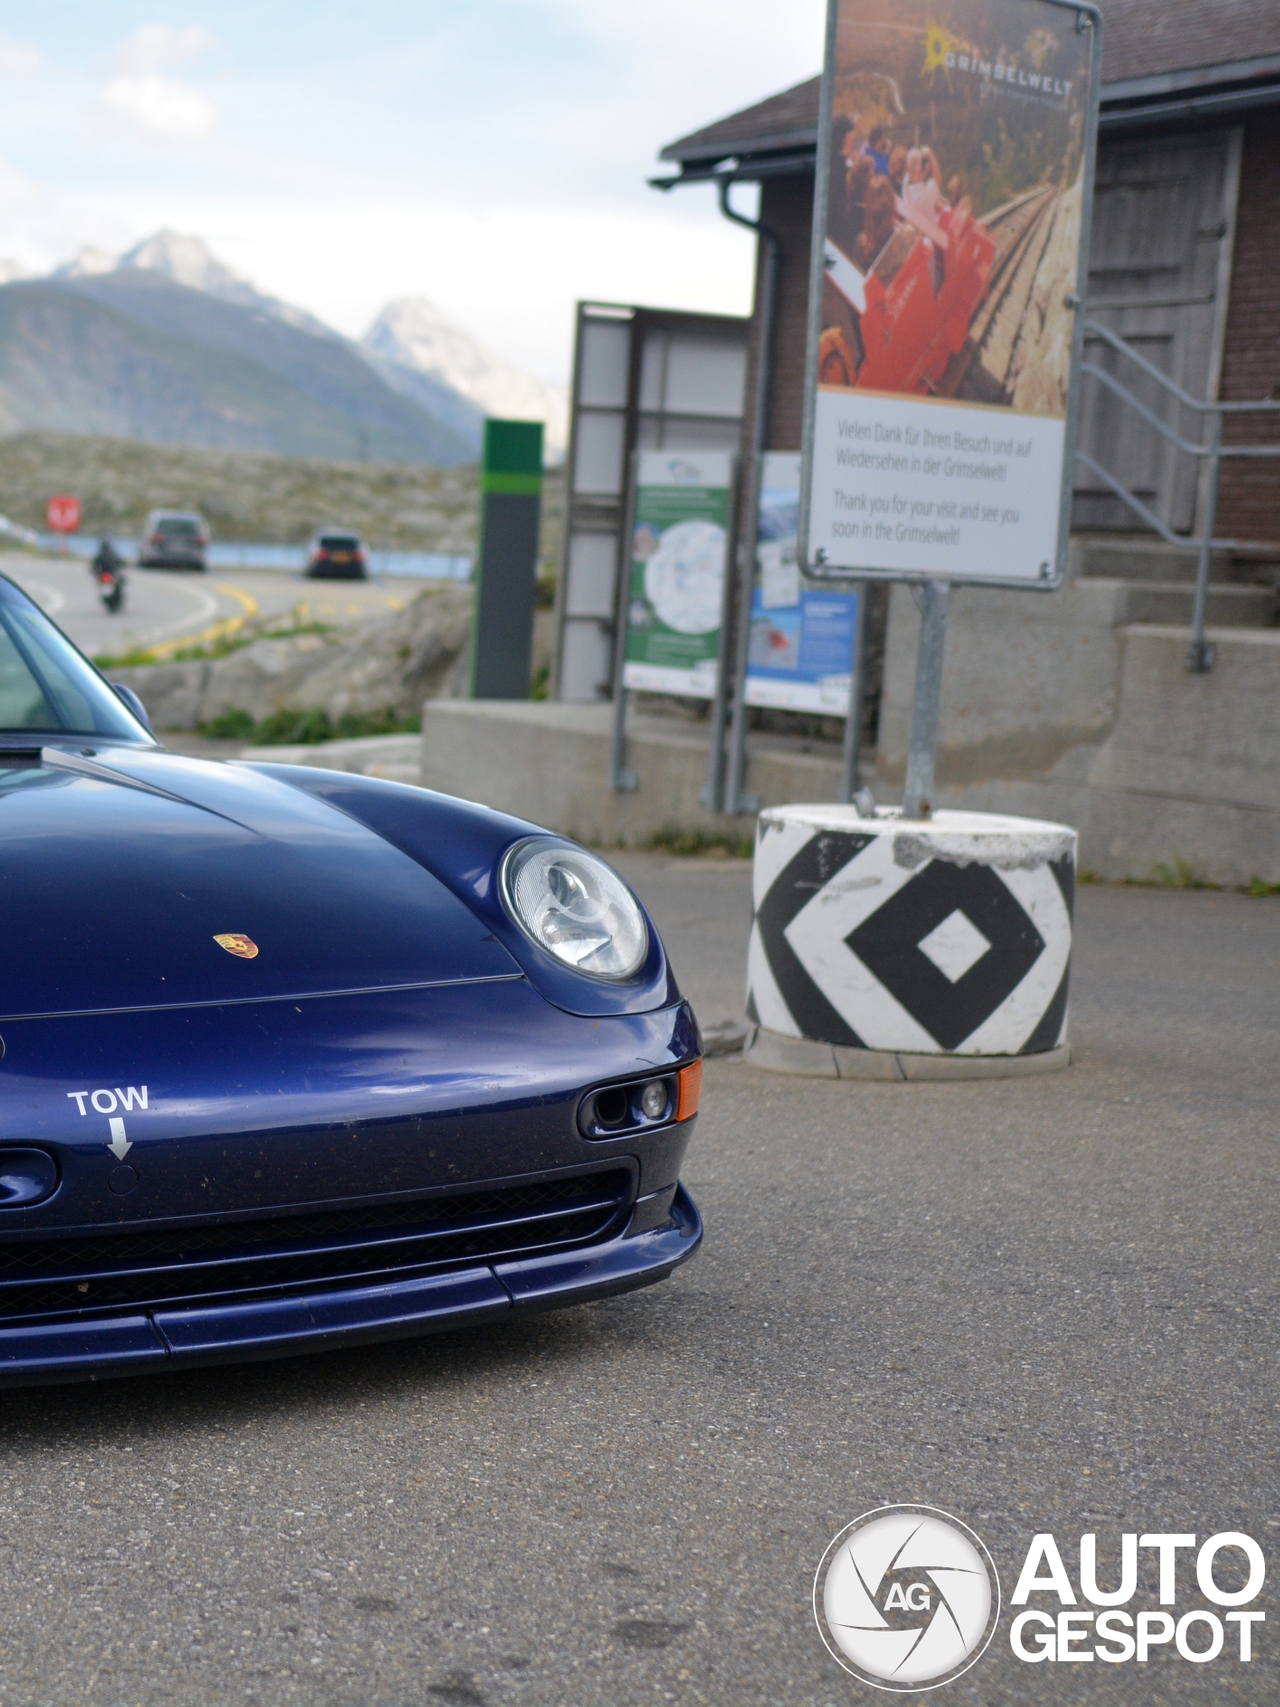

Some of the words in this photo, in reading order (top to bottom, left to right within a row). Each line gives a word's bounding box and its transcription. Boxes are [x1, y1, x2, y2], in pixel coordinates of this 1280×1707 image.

[945, 52, 1072, 95] GRIMSELWELT
[838, 420, 870, 440] Vielen
[875, 422, 902, 443] Dank
[905, 426, 921, 445] für
[924, 428, 951, 449] Ihren
[954, 431, 991, 452] Besuch
[993, 437, 1013, 455] und
[1015, 437, 1032, 458] auf
[836, 447, 908, 471] Wiedersehen
[911, 453, 921, 472] in
[923, 456, 941, 475] der
[944, 456, 1007, 482] Grimselwelt!
[834, 489, 867, 510] Thank
[869, 498, 889, 517] you
[892, 494, 908, 514] for
[910, 501, 934, 520] your
[936, 500, 957, 519] visit
[959, 503, 979, 520] and
[981, 508, 999, 522] see
[1001, 509, 1020, 528] you
[832, 521, 859, 538] soon
[862, 521, 872, 538] in
[875, 522, 893, 541] the
[895, 523, 961, 545] Grimselwelt!
[66, 1085, 149, 1116] TOW
